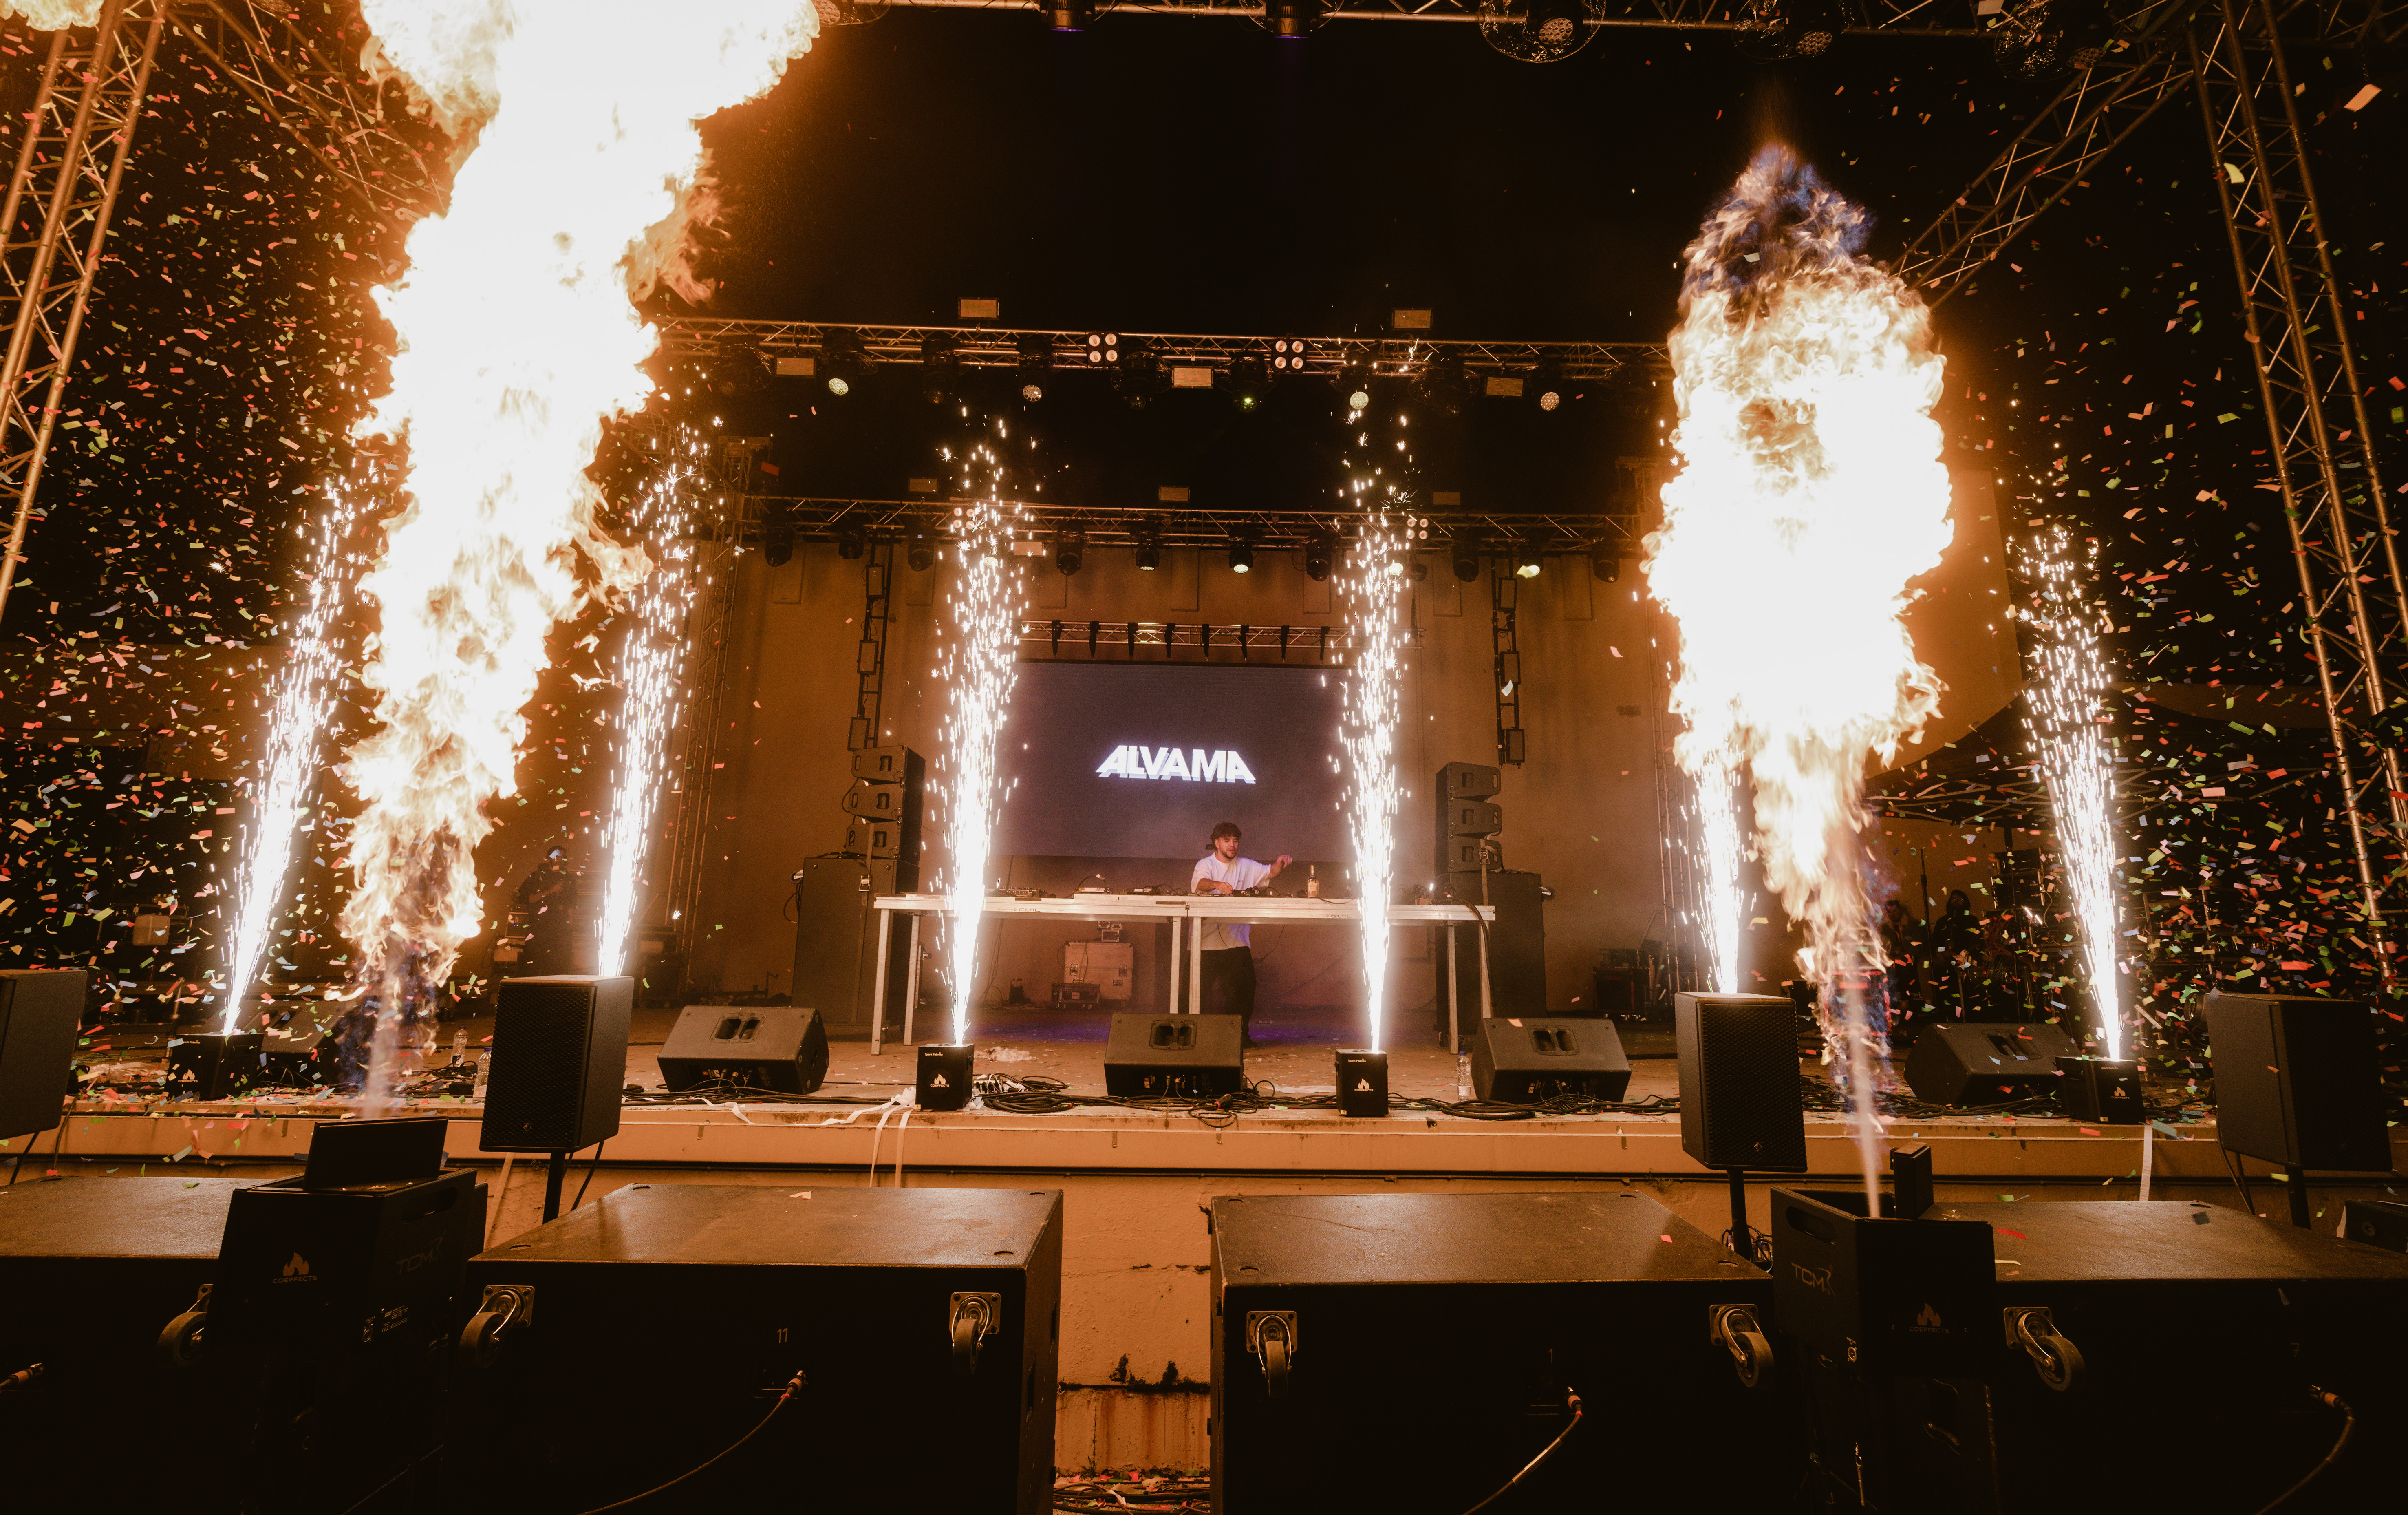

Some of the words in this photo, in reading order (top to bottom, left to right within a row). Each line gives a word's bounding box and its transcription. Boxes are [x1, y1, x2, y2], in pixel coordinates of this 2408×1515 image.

[1095, 745, 1256, 784] ALVAMA
[273, 1275, 318, 1283] COEFFECTS
[776, 1327, 788, 1343] 11
[1548, 1348, 1553, 1363] 1
[2291, 1343, 2300, 1357] 7
